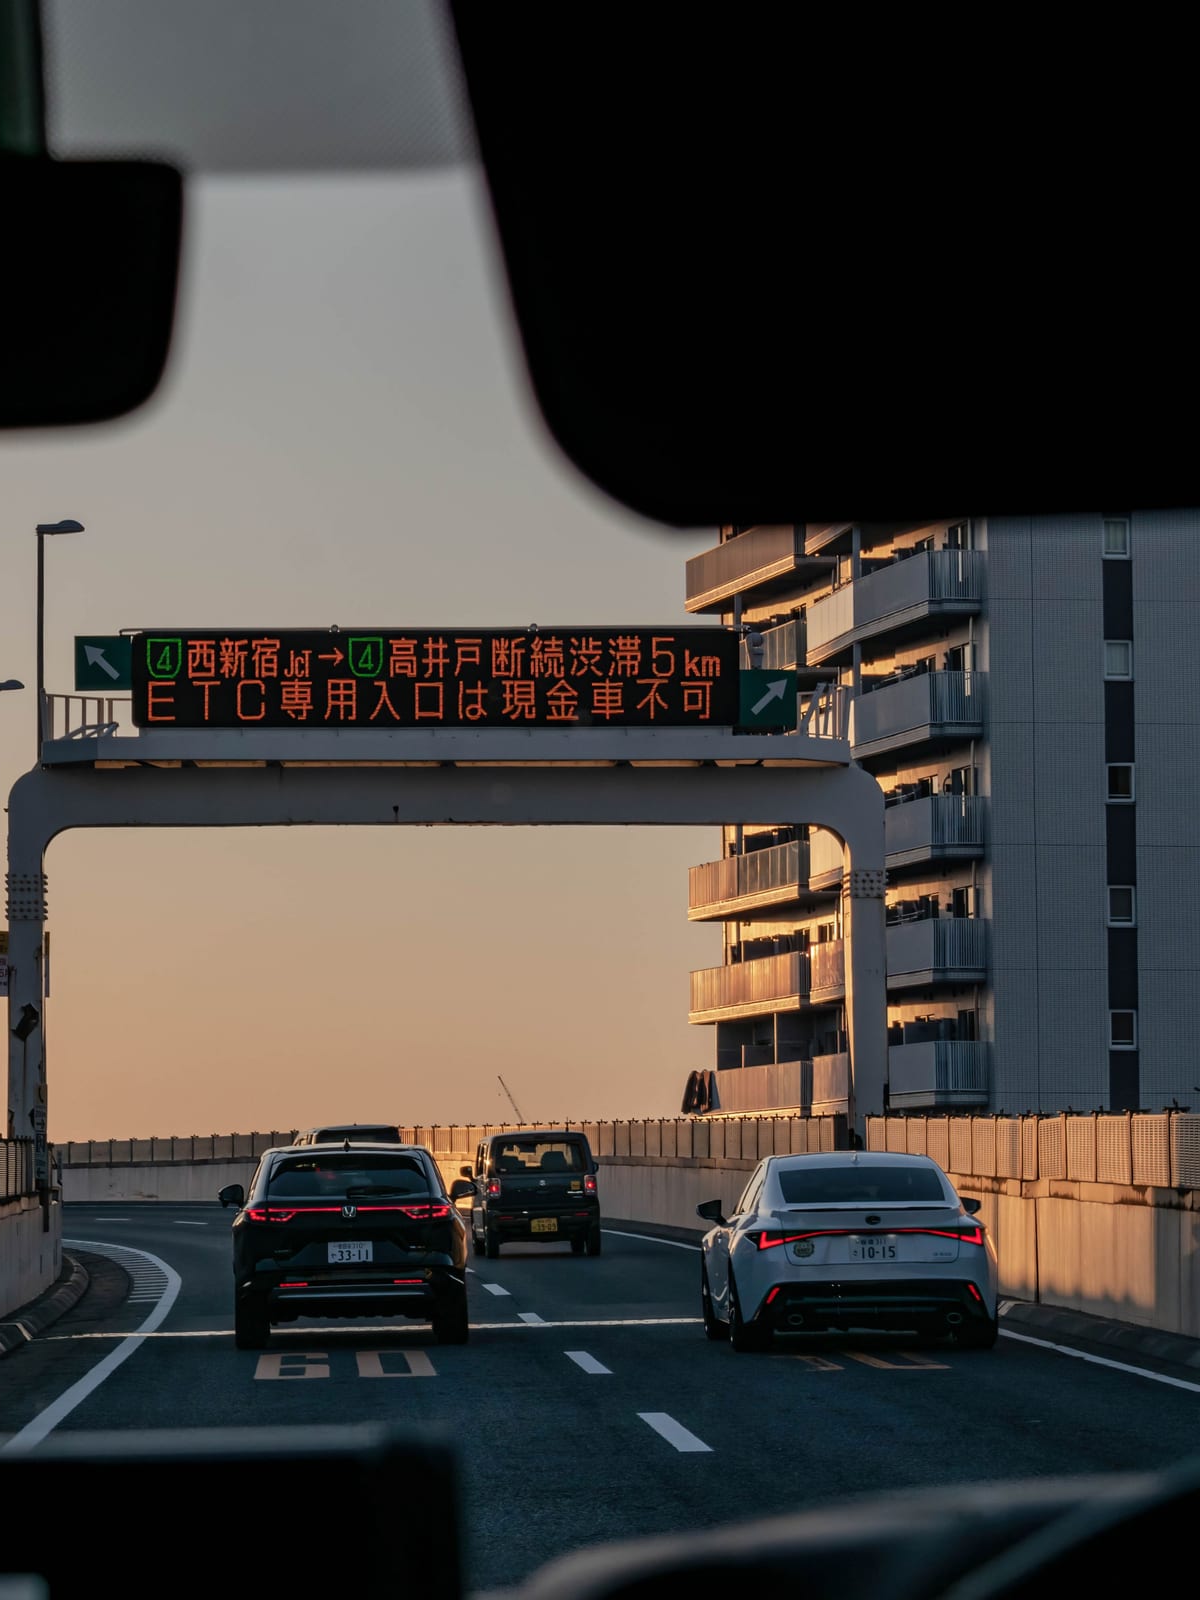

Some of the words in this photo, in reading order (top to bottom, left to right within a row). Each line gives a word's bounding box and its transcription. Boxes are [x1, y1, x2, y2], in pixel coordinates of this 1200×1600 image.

[156, 645, 172, 671] 4
[358, 643, 374, 670] 4
[337, 1249, 369, 1261] 33-11
[862, 1245, 896, 1259] 10-15
[254, 1350, 438, 1380] 60
